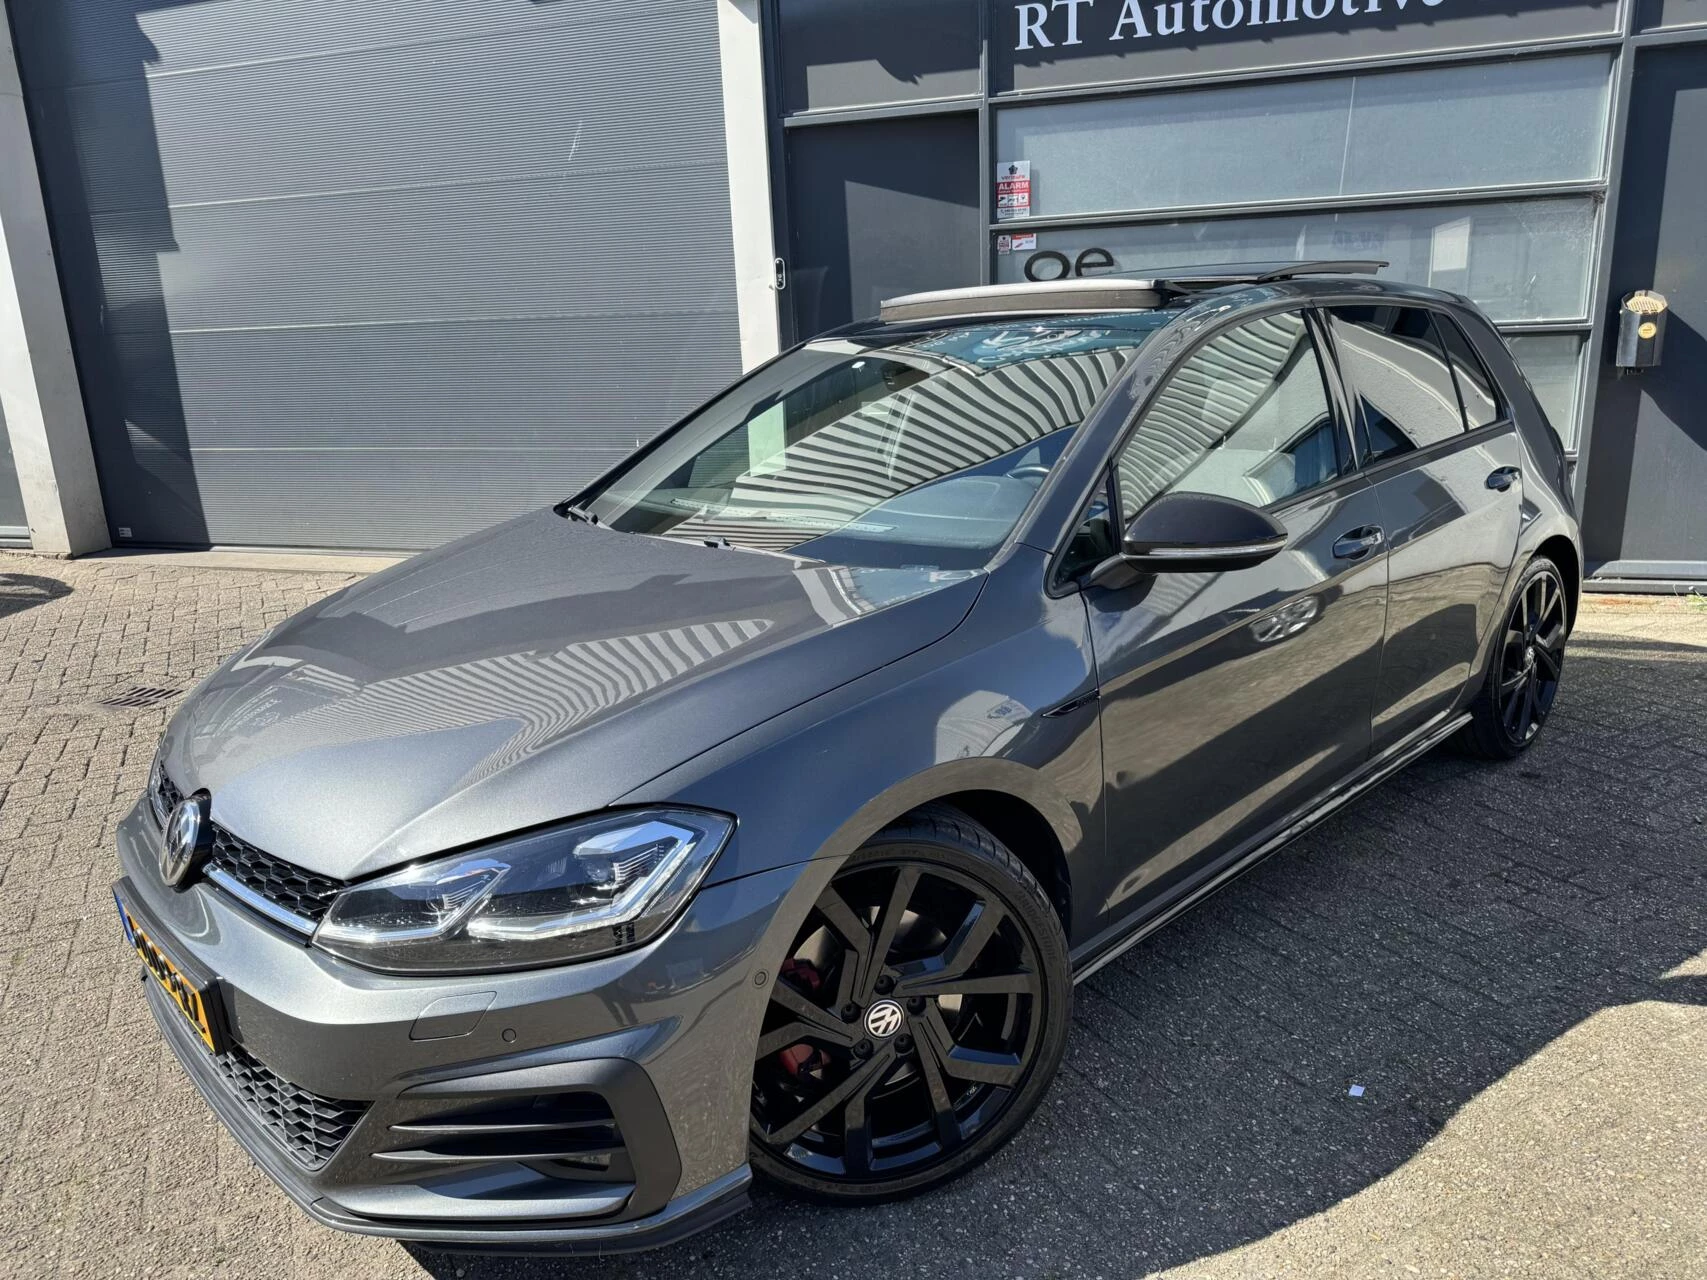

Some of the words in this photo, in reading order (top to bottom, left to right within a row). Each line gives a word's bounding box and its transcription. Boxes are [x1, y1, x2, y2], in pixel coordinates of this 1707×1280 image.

[1014, 0, 1094, 51] RT
[1109, 0, 1441, 41] Automo
[998, 182, 1029, 190] ALARM
